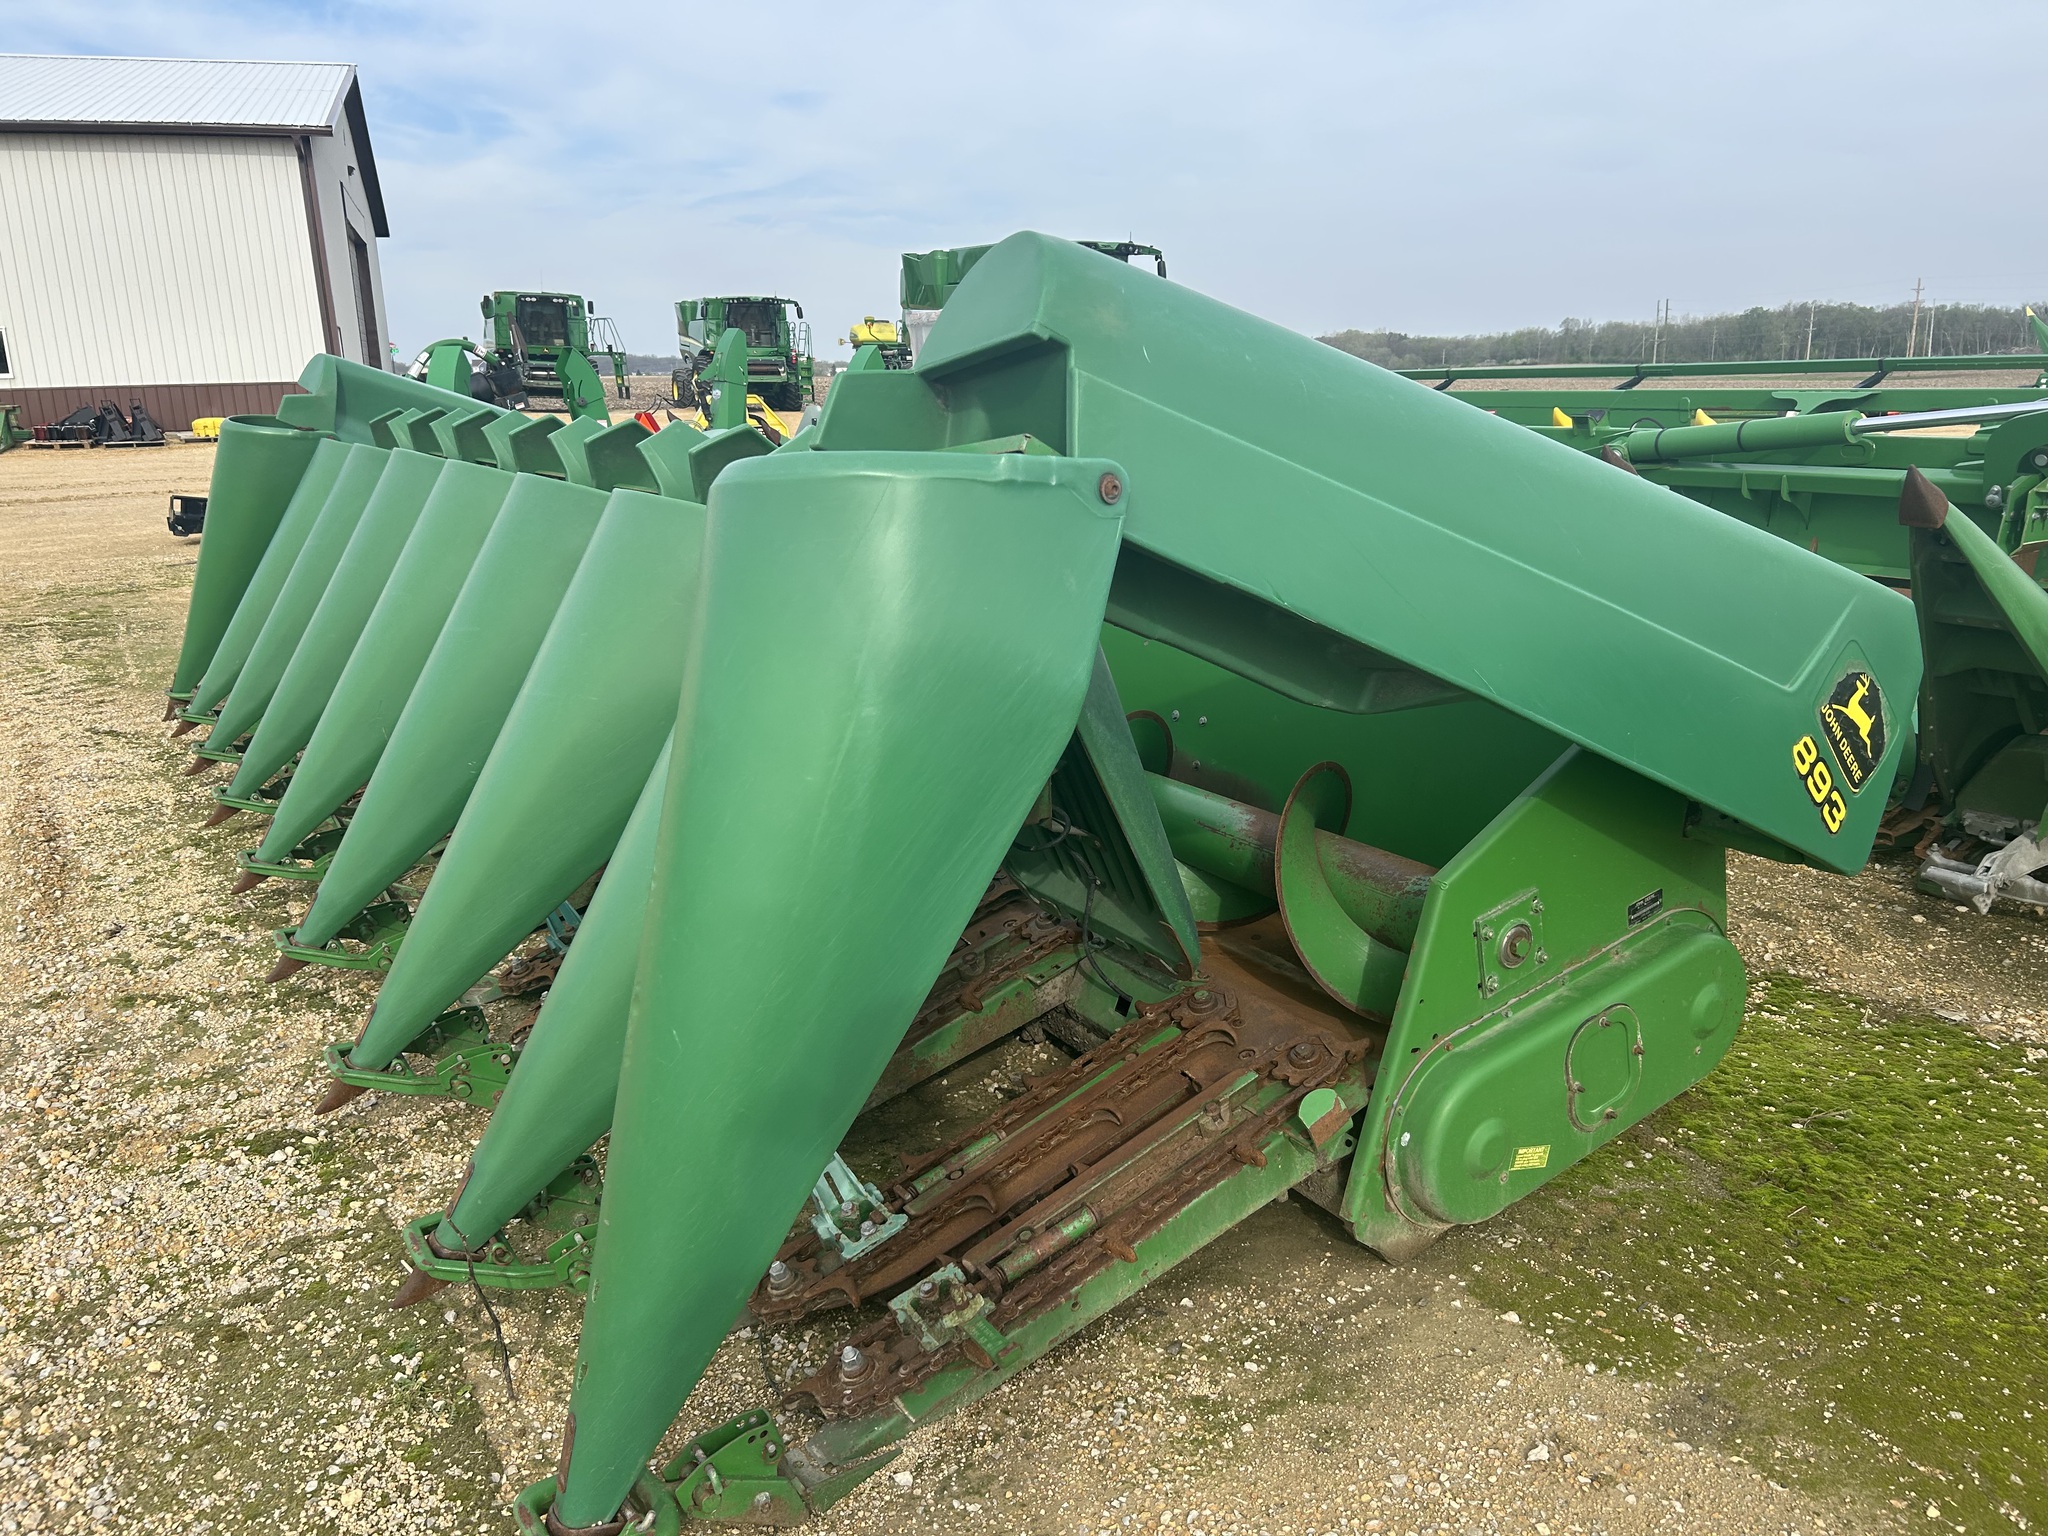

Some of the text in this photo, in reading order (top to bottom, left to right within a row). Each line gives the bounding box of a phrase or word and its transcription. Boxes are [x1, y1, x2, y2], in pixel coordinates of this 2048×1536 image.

[1793, 735, 1846, 833] 893
[1821, 704, 1863, 783] JOHN DEERE
